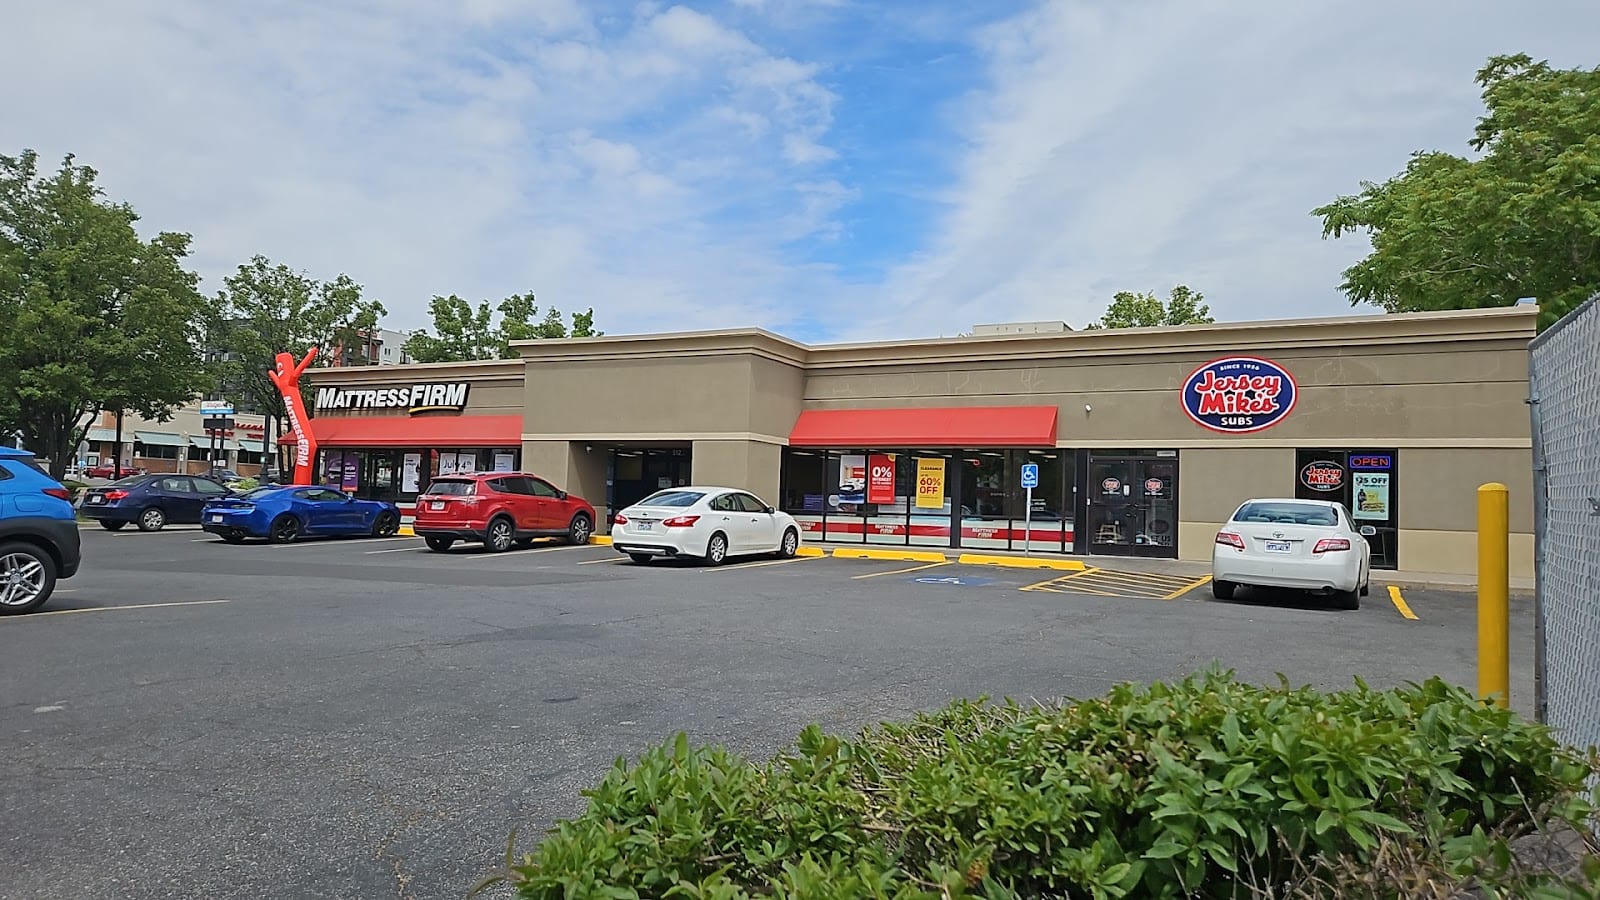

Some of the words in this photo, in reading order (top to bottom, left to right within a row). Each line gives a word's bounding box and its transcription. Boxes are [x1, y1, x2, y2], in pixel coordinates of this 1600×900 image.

[1195, 370, 1281, 397] Jersey
[1198, 391, 1279, 415] Mike's
[1221, 416, 1253, 426] SUBS
[1352, 457, 1388, 467] OPEN
[872, 466, 892, 478] 0%
[1306, 466, 1342, 479] Jersey
[920, 477, 941, 487] 60%
[1371, 477, 1388, 485] OFF
[920, 486, 939, 494] OFF
